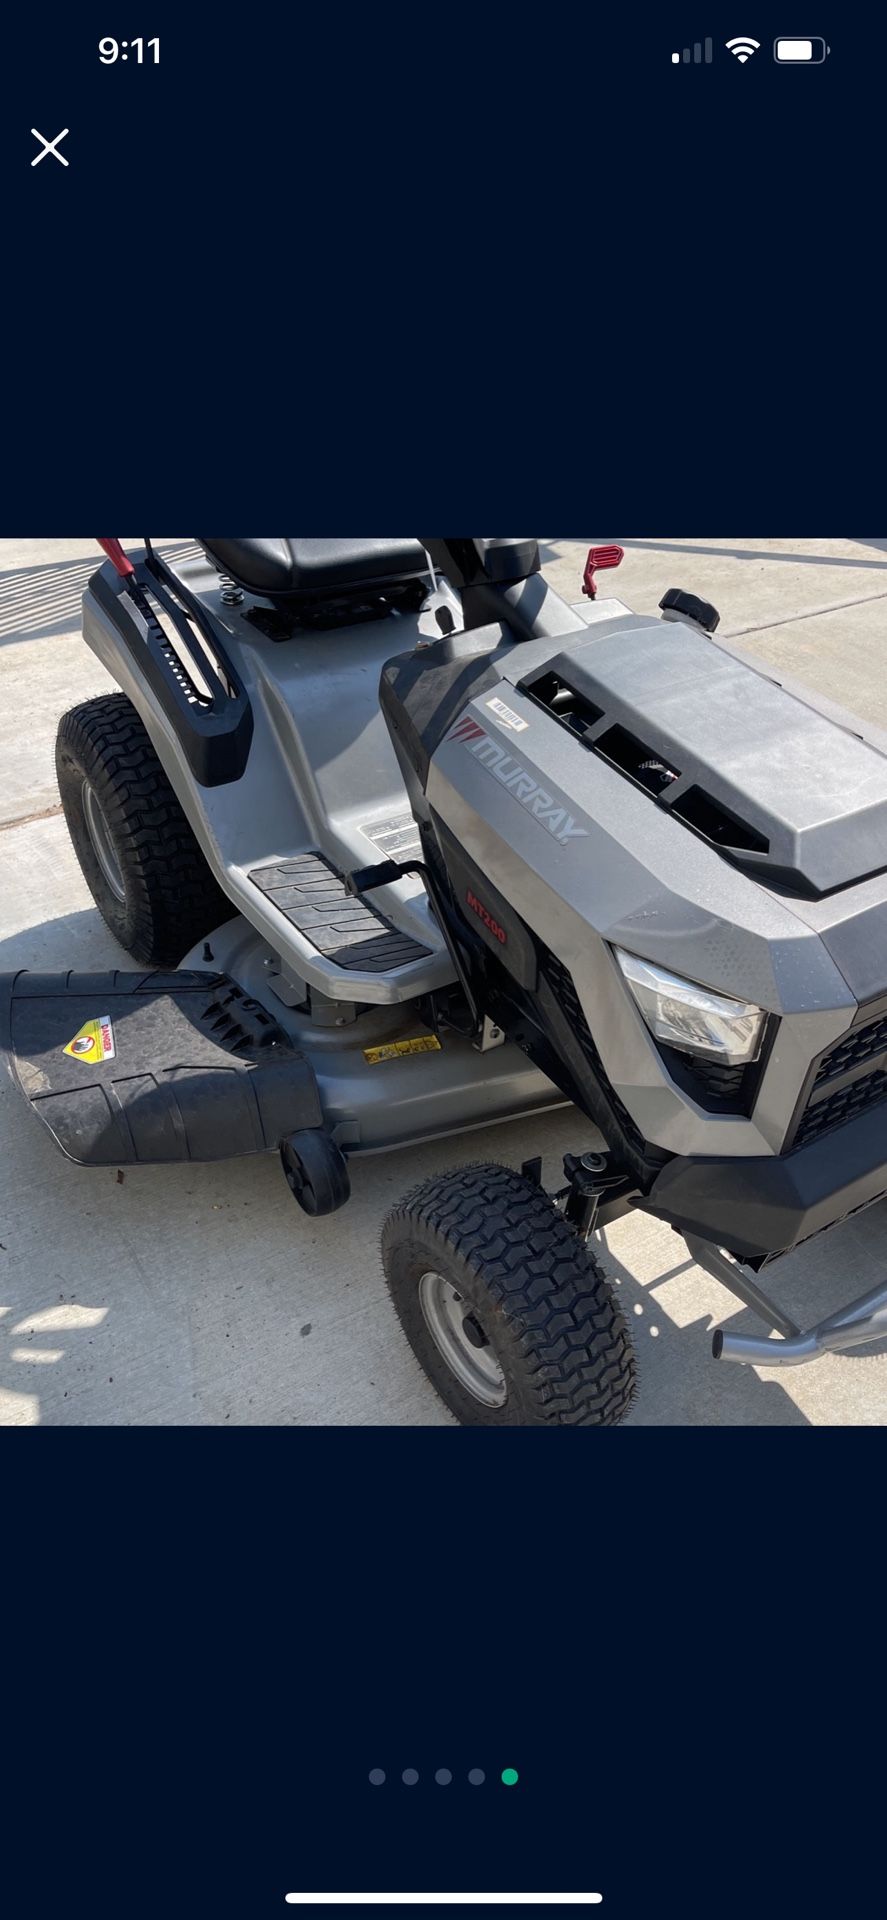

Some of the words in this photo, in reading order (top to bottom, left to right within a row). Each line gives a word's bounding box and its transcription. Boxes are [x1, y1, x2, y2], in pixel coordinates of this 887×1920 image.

[471, 736, 591, 841] MURRAY
[466, 888, 507, 944] MT200
[101, 1023, 112, 1052] DANGER
